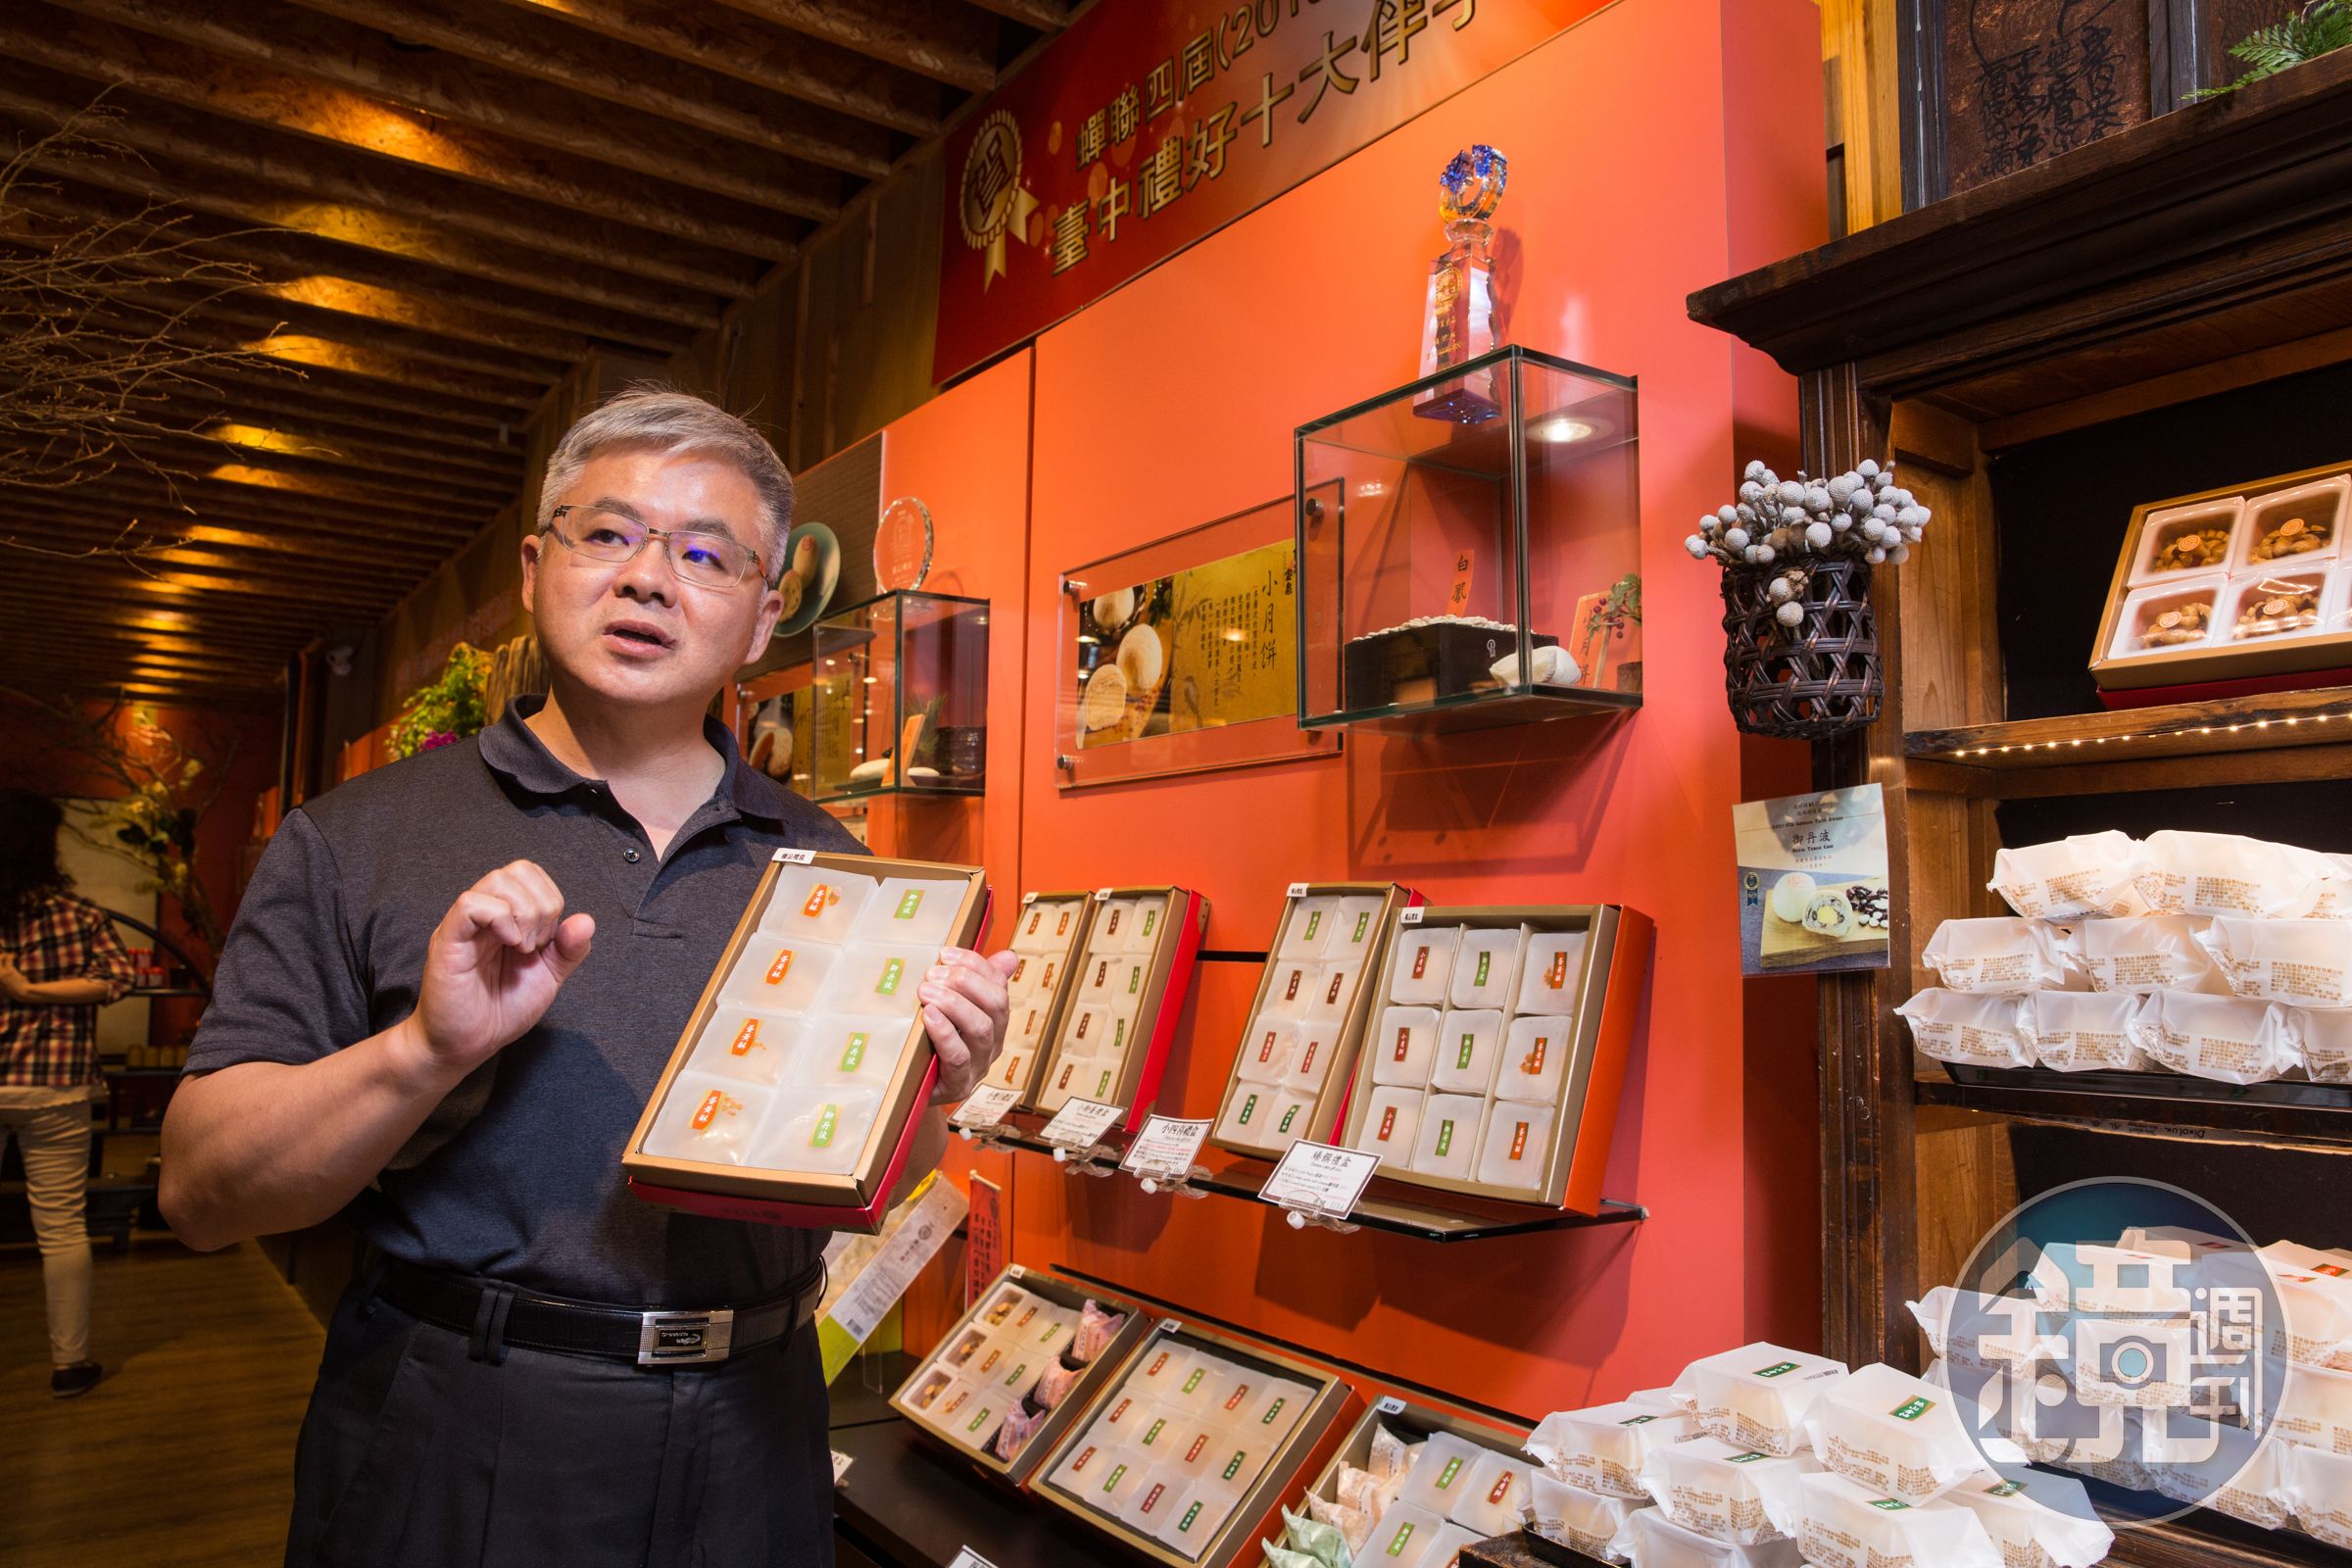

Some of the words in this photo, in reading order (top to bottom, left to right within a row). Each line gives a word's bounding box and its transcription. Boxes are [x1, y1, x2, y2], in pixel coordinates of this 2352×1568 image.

[1075, 0, 1320, 172] 蟬聯四屆(20
[1261, 569, 1278, 670] 小月餅
[1792, 829, 1831, 845] 御丹波
